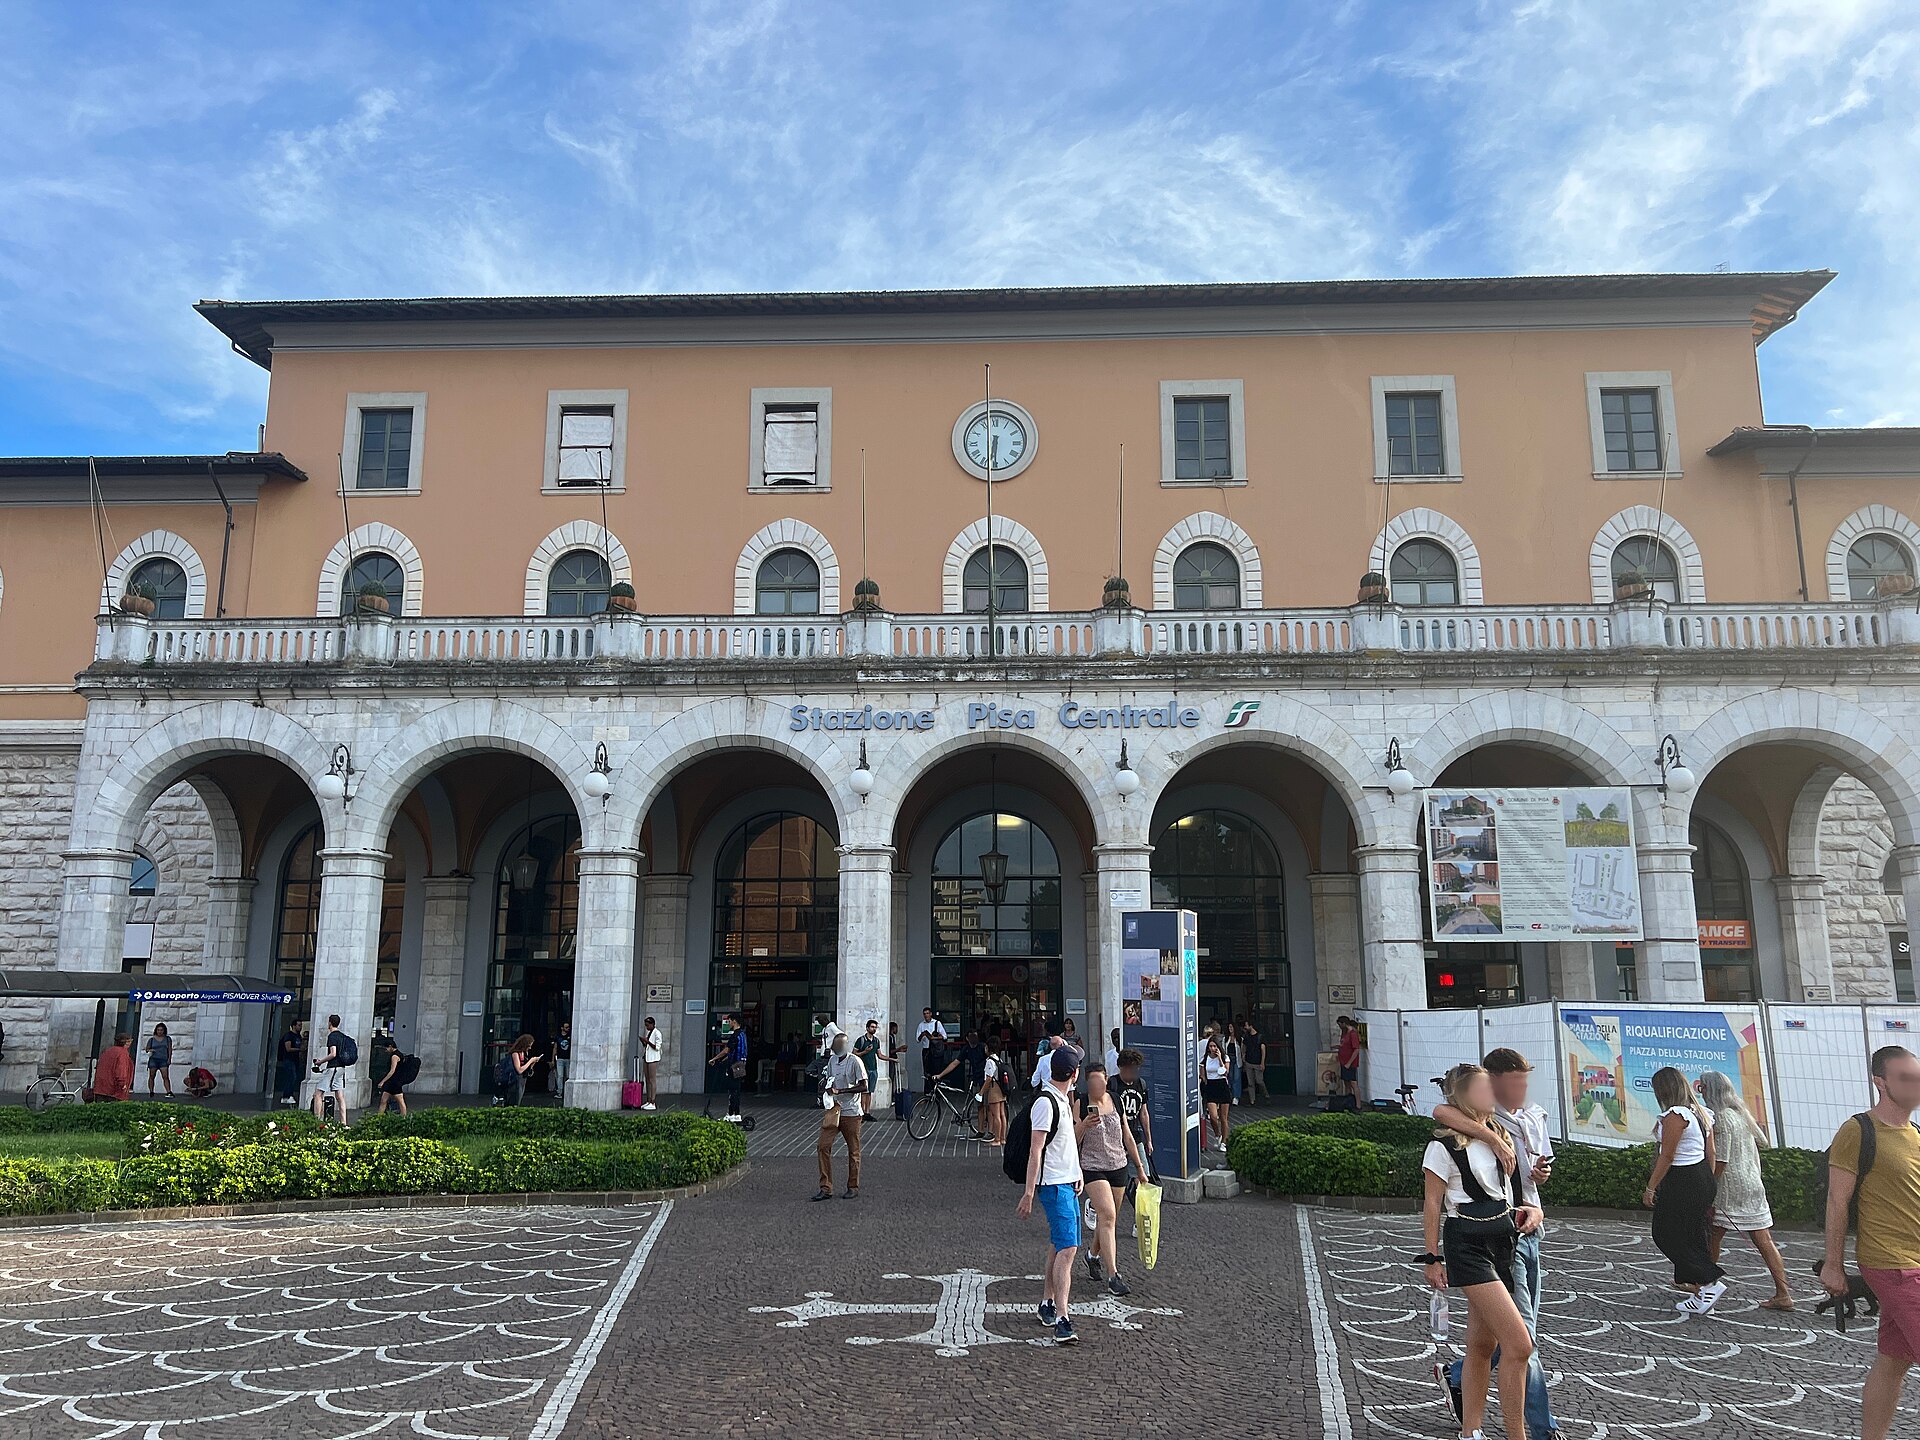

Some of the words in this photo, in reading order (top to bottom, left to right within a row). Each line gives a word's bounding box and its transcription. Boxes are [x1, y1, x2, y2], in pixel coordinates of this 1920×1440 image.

[790, 704, 935, 732] Stazione
[968, 702, 1036, 730] Pisa
[1059, 701, 1200, 729] Centrale
[153, 991, 199, 1001] Aeroporto
[222, 992, 260, 1000] PISMOVER
[260, 993, 282, 1002] Shuttle
[1569, 1023, 1595, 1033] PIAZZA
[1596, 1024, 1618, 1034] DELLA
[1625, 1025, 1727, 1041] RIQUALIFICAZIONE
[1575, 1032, 1611, 1041] STAZIONE
[1629, 1046, 1656, 1057] PIAZZA
[1658, 1047, 1682, 1059] DELLA
[1683, 1049, 1727, 1061] STAZIONE
[1644, 1062, 1648, 1070] E
